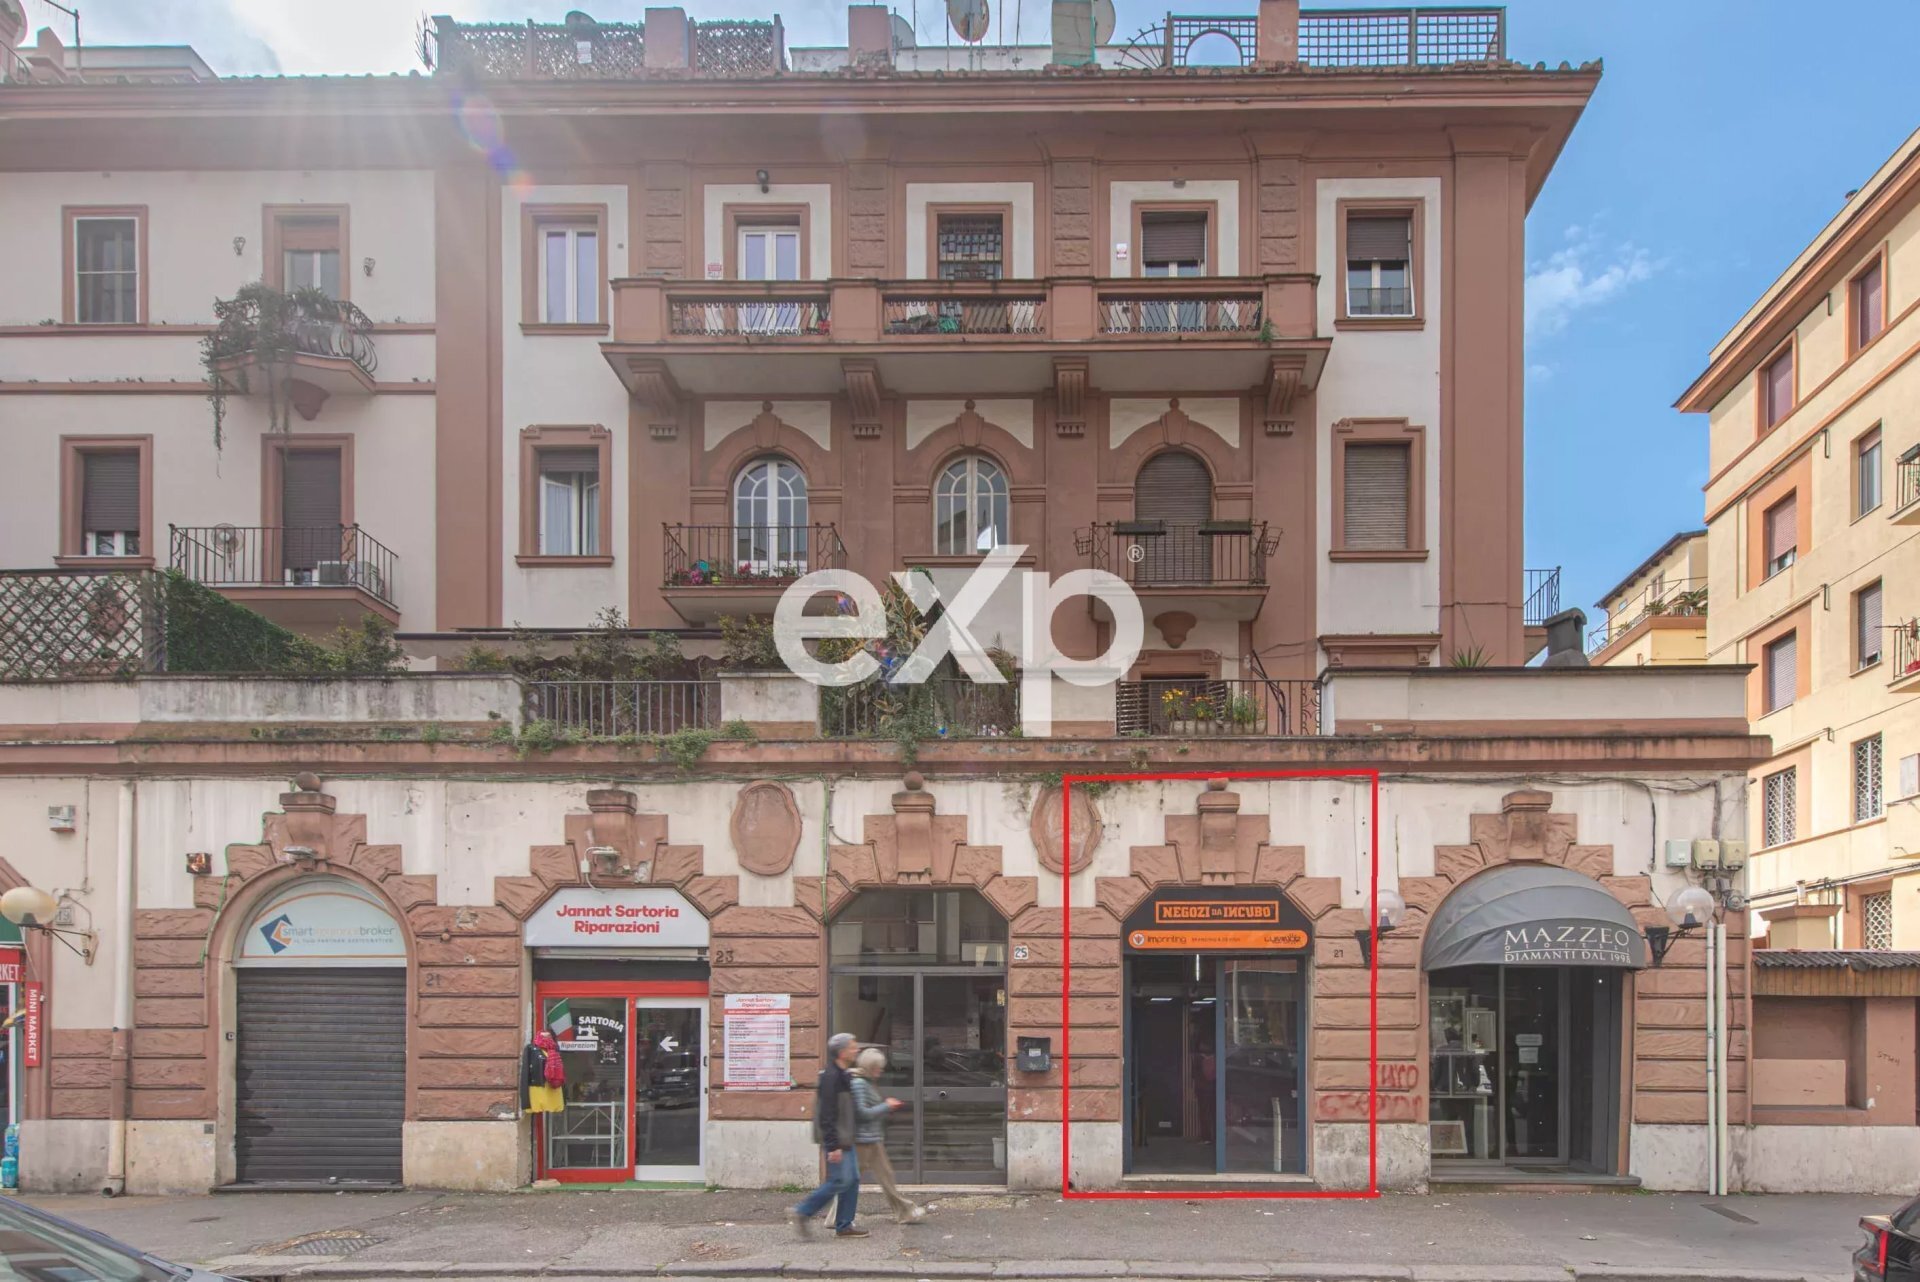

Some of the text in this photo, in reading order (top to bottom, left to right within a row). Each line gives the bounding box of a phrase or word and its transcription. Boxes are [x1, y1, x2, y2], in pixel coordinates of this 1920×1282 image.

[556, 904, 679, 918] Jannat Sartoria
[1162, 906, 1211, 918] NEGOZI
[1223, 906, 1271, 918] INCUBO
[574, 920, 660, 935] Riparazioni
[1504, 926, 1629, 946] MAZZEO
[716, 950, 734, 963] 23
[1014, 947, 1028, 958] 25
[1504, 951, 1576, 962] DIAMANTI
[1581, 951, 1606, 960] DAL
[425, 973, 441, 986] 21
[27, 988, 38, 1061] MINI MARKET
[578, 1016, 624, 1033] SARTORIA
